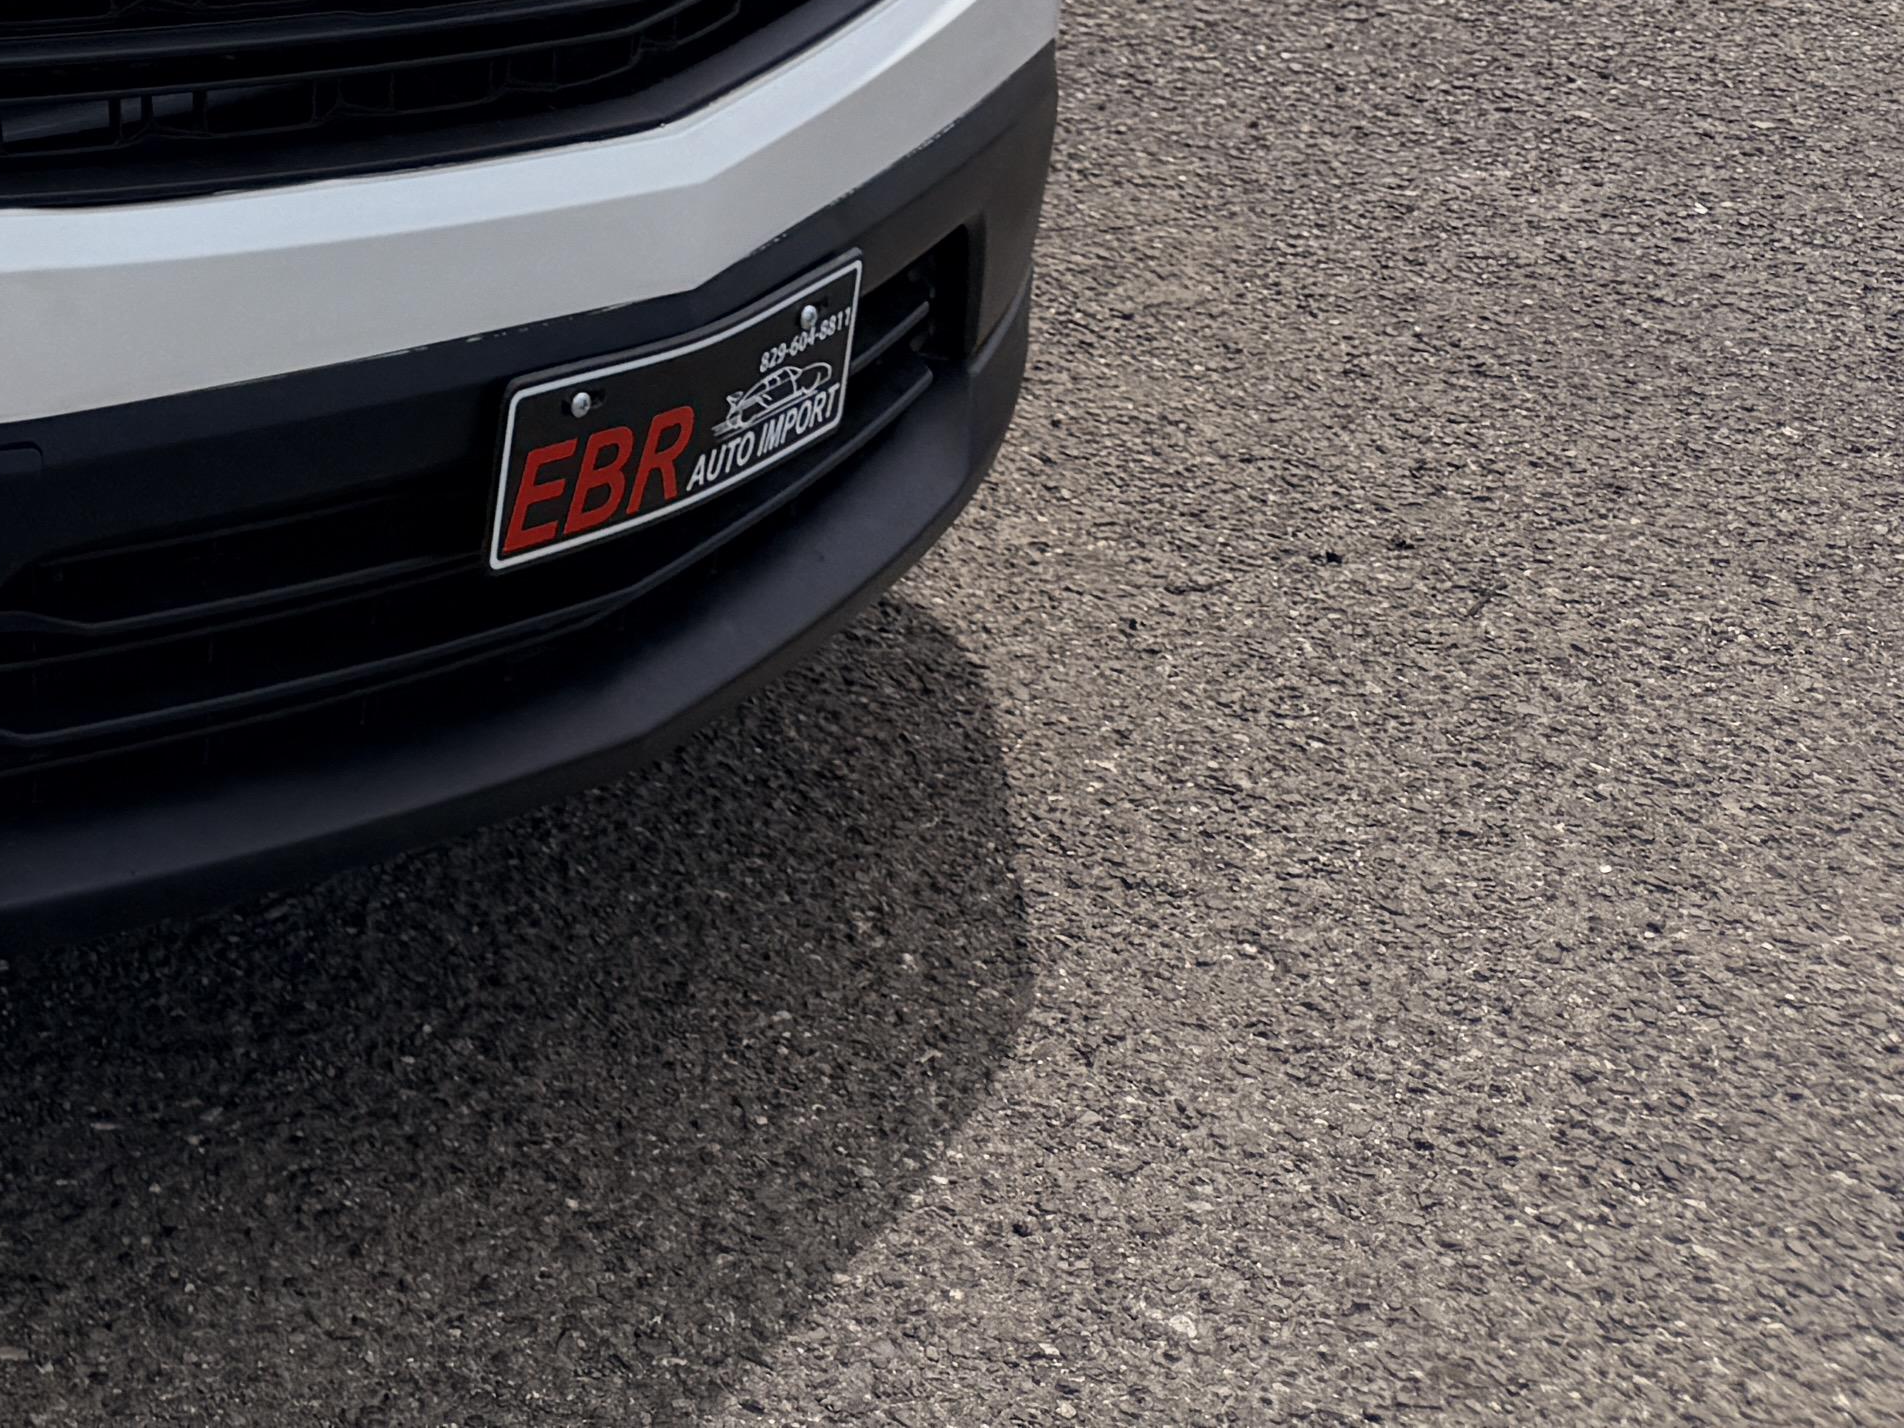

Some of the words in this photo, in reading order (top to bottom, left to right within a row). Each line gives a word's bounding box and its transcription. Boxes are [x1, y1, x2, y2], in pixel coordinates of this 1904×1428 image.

[759, 306, 852, 373] 829-604-8811
[502, 405, 695, 555] EBR
[686, 425, 759, 491] AUTO
[757, 382, 841, 459] IMPORT
